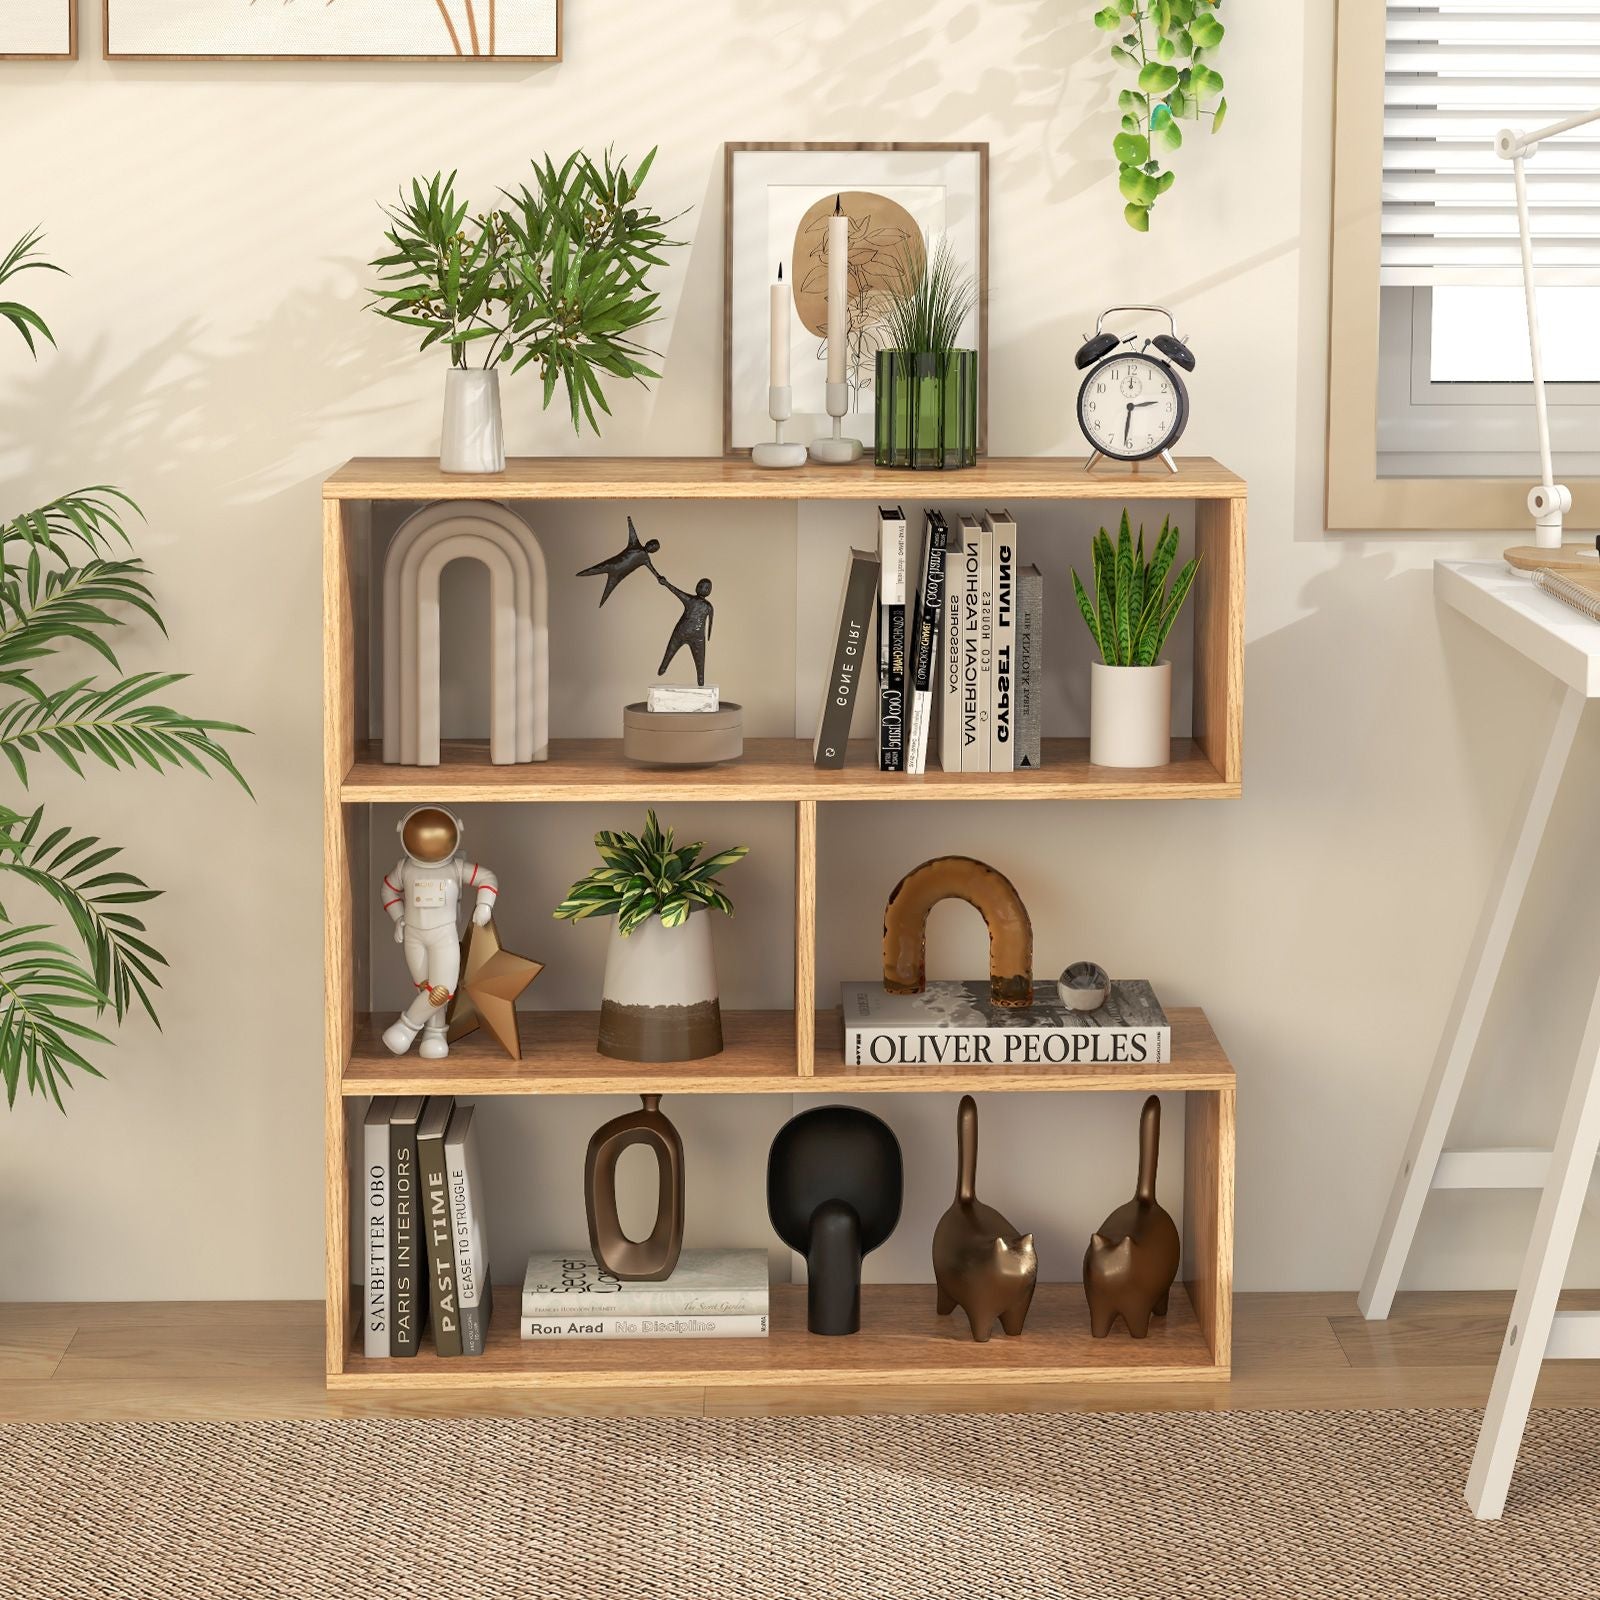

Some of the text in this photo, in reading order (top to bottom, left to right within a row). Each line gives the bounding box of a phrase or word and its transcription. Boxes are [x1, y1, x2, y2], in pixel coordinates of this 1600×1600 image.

[1111, 370, 1119, 380] 11
[1127, 365, 1138, 376] 12
[1149, 370, 1152, 380] 1
[1097, 383, 1106, 393] 10
[1161, 384, 1168, 393] 2
[1089, 402, 1096, 412] 9
[1166, 403, 1172, 412] 3
[1095, 420, 1101, 430] 8
[1158, 422, 1165, 430] 4
[1109, 434, 1114, 444] 7
[1126, 439, 1133, 448] 6
[1147, 434, 1154, 444] 5
[870, 1033, 1147, 1064] OLIVER PEOPLES
[453, 1169, 468, 1235] STRUGGLE
[370, 1165, 385, 1332] SANBETTER OBO
[397, 1148, 411, 1343] PARIS INTERIORS
[458, 1239, 469, 1254] TO
[428, 1171, 456, 1332] PAST TIME
[461, 1258, 474, 1299] CEASE
[531, 1319, 716, 1335] Ron Arad No Discipline
